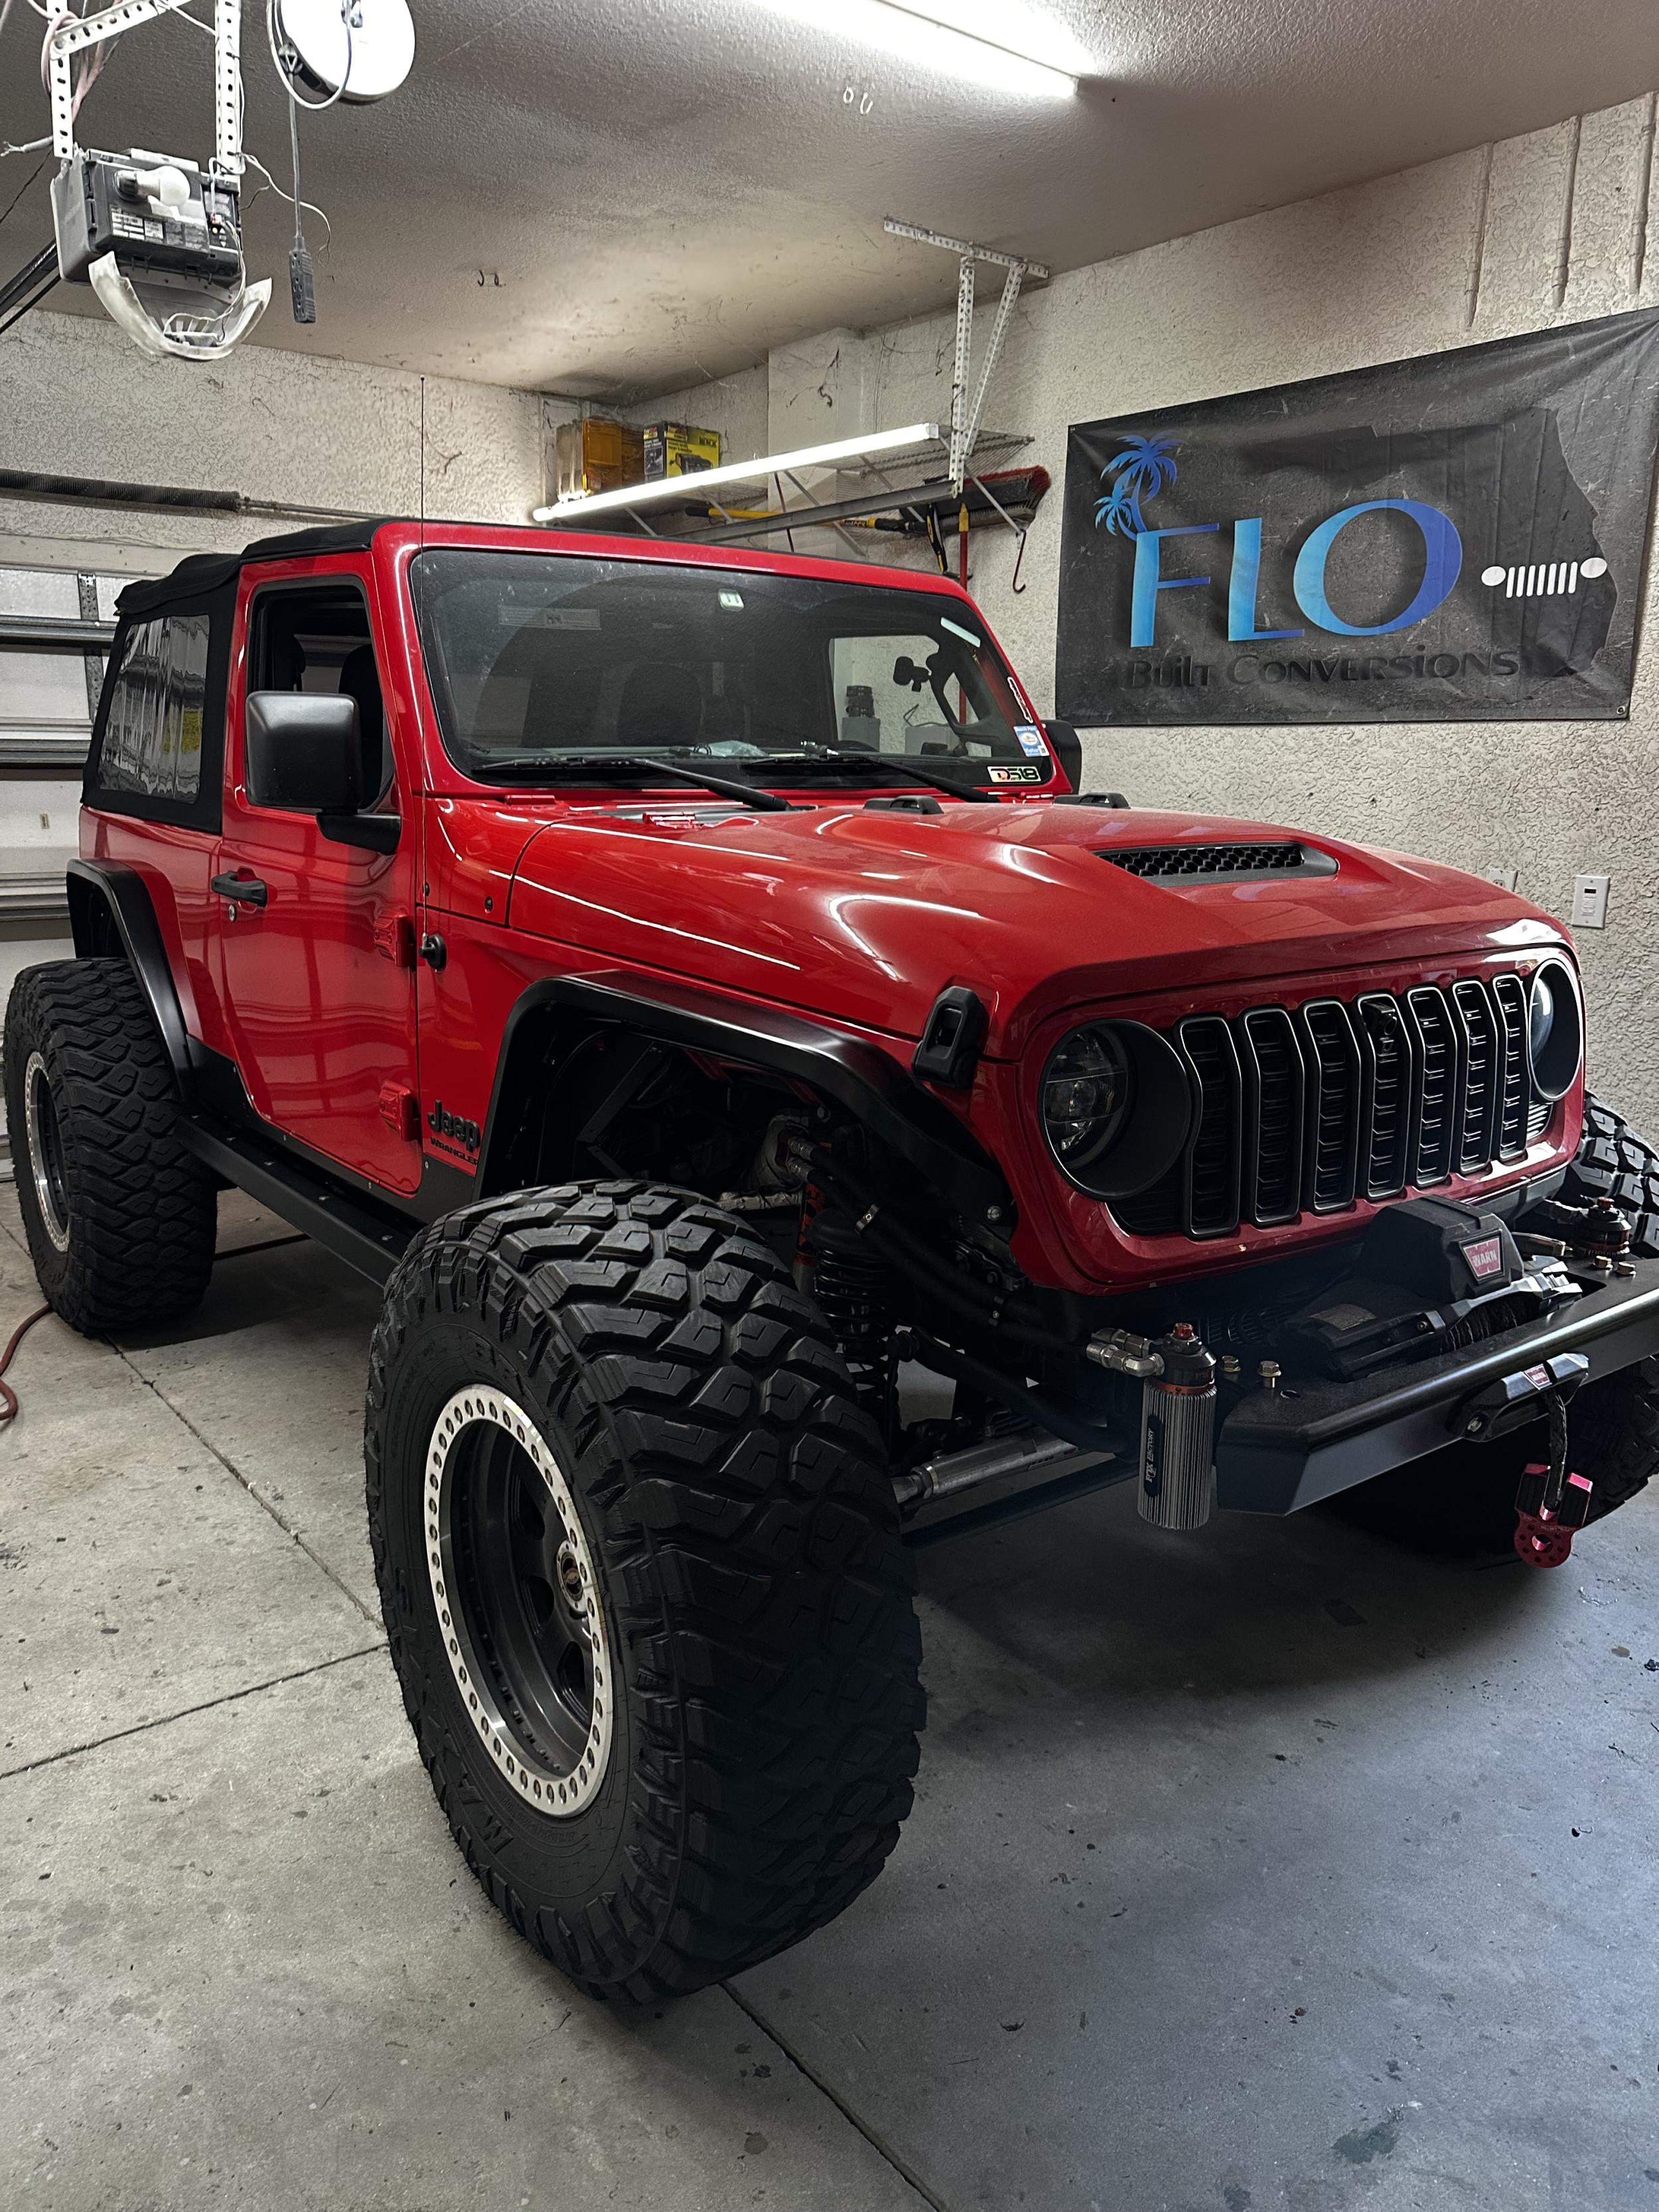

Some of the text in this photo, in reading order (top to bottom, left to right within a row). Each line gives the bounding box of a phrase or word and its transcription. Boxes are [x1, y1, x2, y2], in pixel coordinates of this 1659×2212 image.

[1130, 498, 1463, 648] FLO
[427, 1099, 481, 1153] Jeep
[1472, 1249, 1498, 1267] WARN
[1145, 1461, 1157, 1483] FOX
